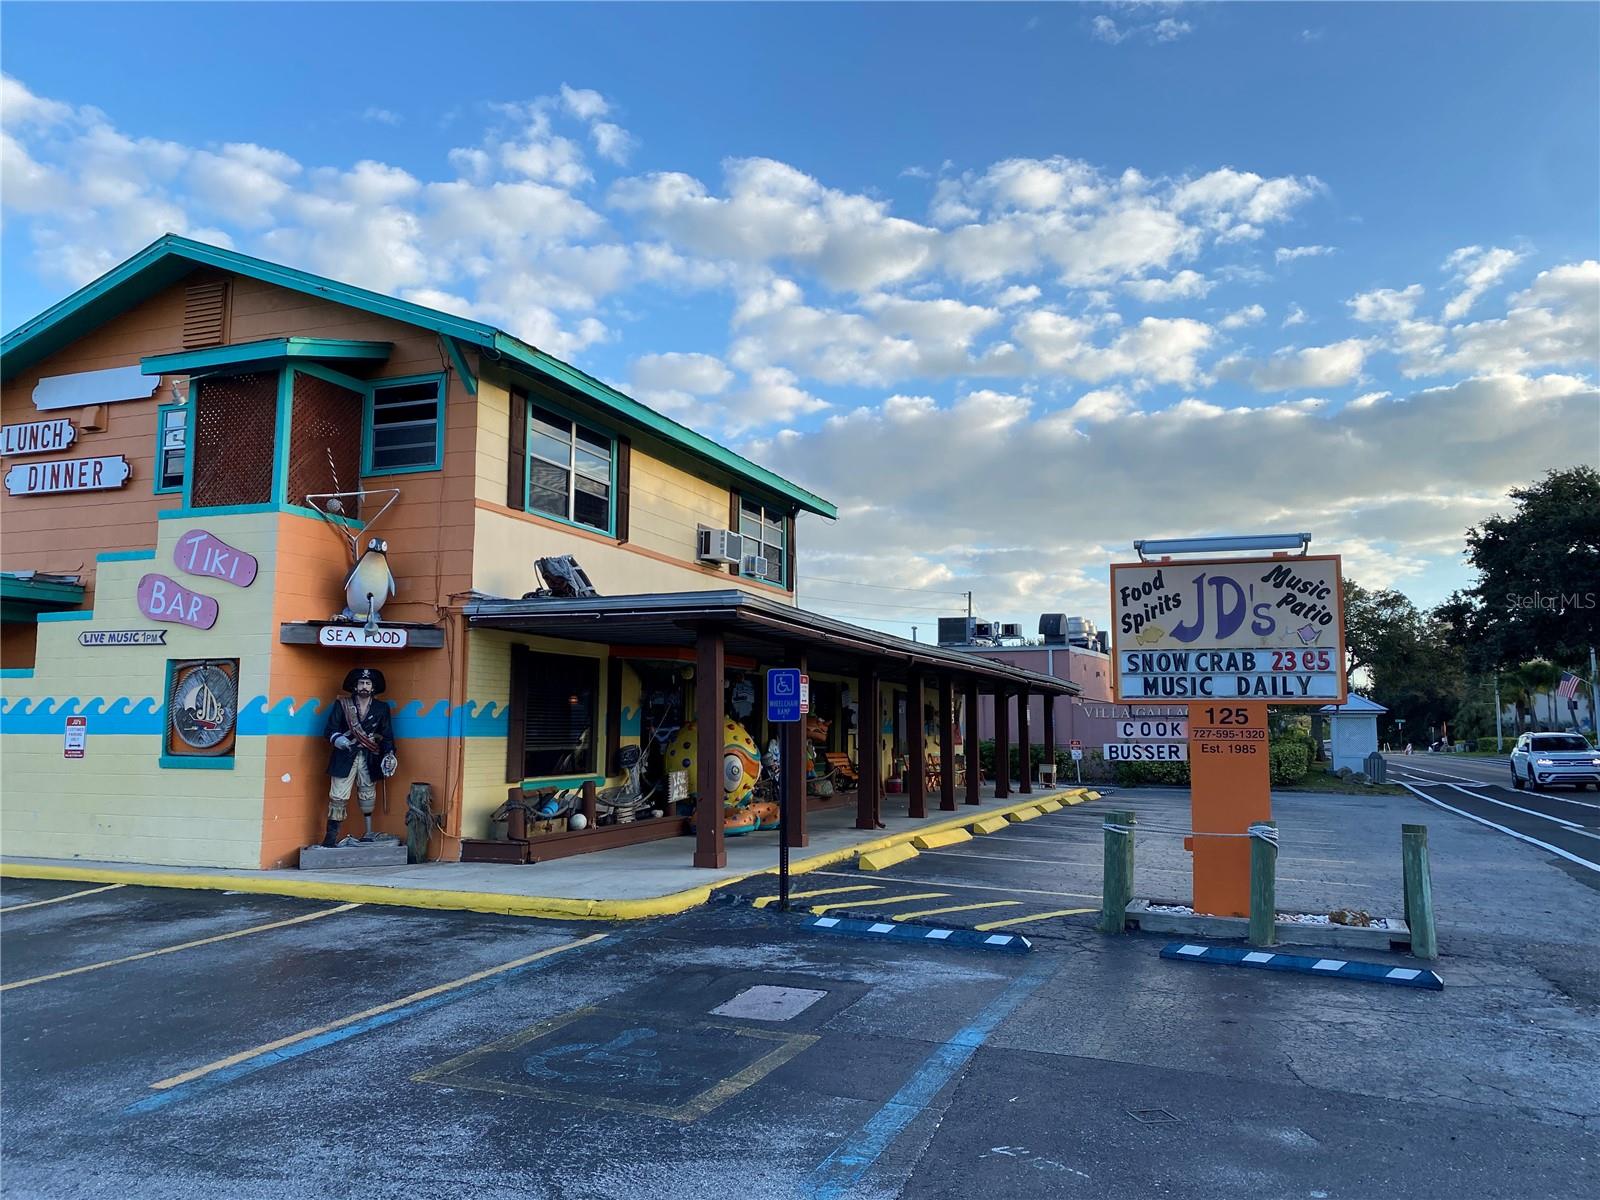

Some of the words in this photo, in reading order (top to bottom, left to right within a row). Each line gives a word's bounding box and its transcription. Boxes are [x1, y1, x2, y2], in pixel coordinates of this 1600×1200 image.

[5, 422, 64, 452] LUNCH
[27, 460, 104, 491] DINNER
[186, 534, 239, 580] TIKI
[1120, 569, 1165, 607] Food
[1260, 564, 1331, 600] Music
[150, 580, 202, 623] BAR
[1121, 592, 1182, 634] Spirits
[1169, 572, 1276, 643] JD's
[1275, 592, 1333, 626] Patio
[84, 633, 106, 643] LIVE
[108, 632, 140, 643] MUSIC
[326, 629, 357, 642] SEA
[1127, 652, 1190, 673] SNOW
[1195, 652, 1257, 671] CRAB
[1143, 677, 1213, 696] MUSIC
[1237, 676, 1312, 695] DAILY
[196, 682, 225, 723] JD's
[1084, 707, 1130, 718] VILLA
[1205, 707, 1249, 725] 125
[1123, 722, 1182, 737] COOK
[1193, 729, 1265, 739] 727-595-1320
[1108, 745, 1181, 760] BUSSER
[1201, 743, 1224, 754] Est.
[1228, 744, 1257, 754] 1985
